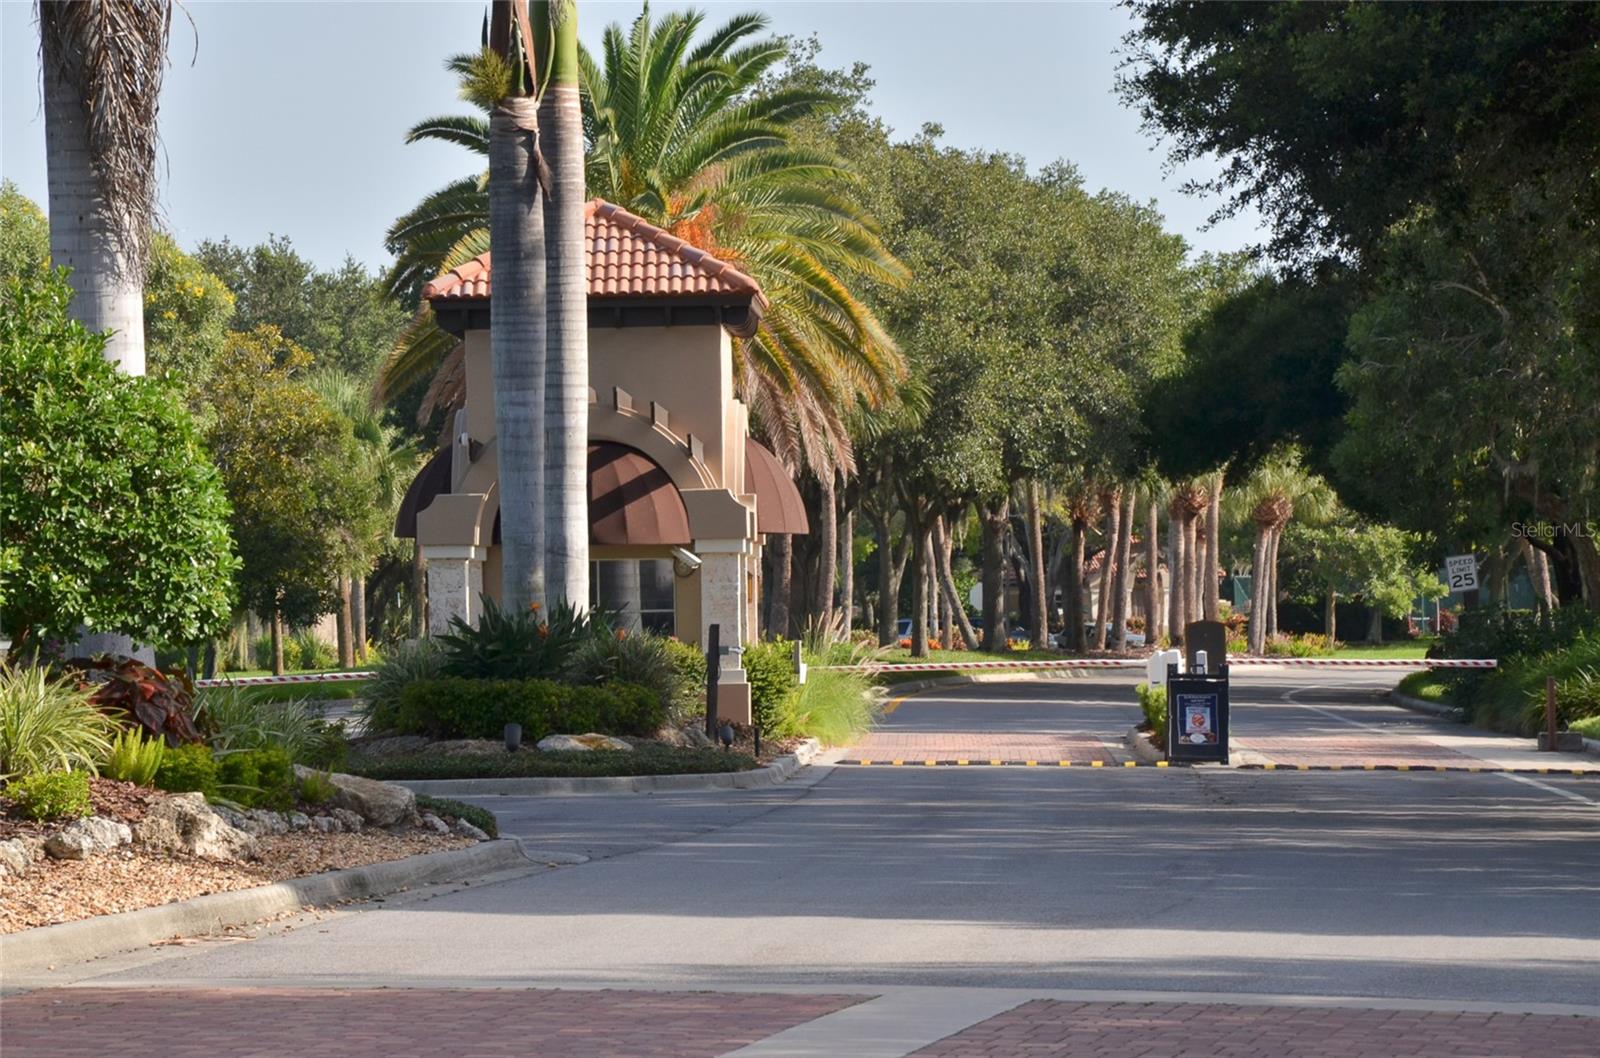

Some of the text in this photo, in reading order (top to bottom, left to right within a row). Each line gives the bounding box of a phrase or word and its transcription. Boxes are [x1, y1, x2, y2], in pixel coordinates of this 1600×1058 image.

[1448, 557, 1473, 567] SPEED
[1450, 565, 1471, 574] LIMIT
[1452, 573, 1475, 588] 25
